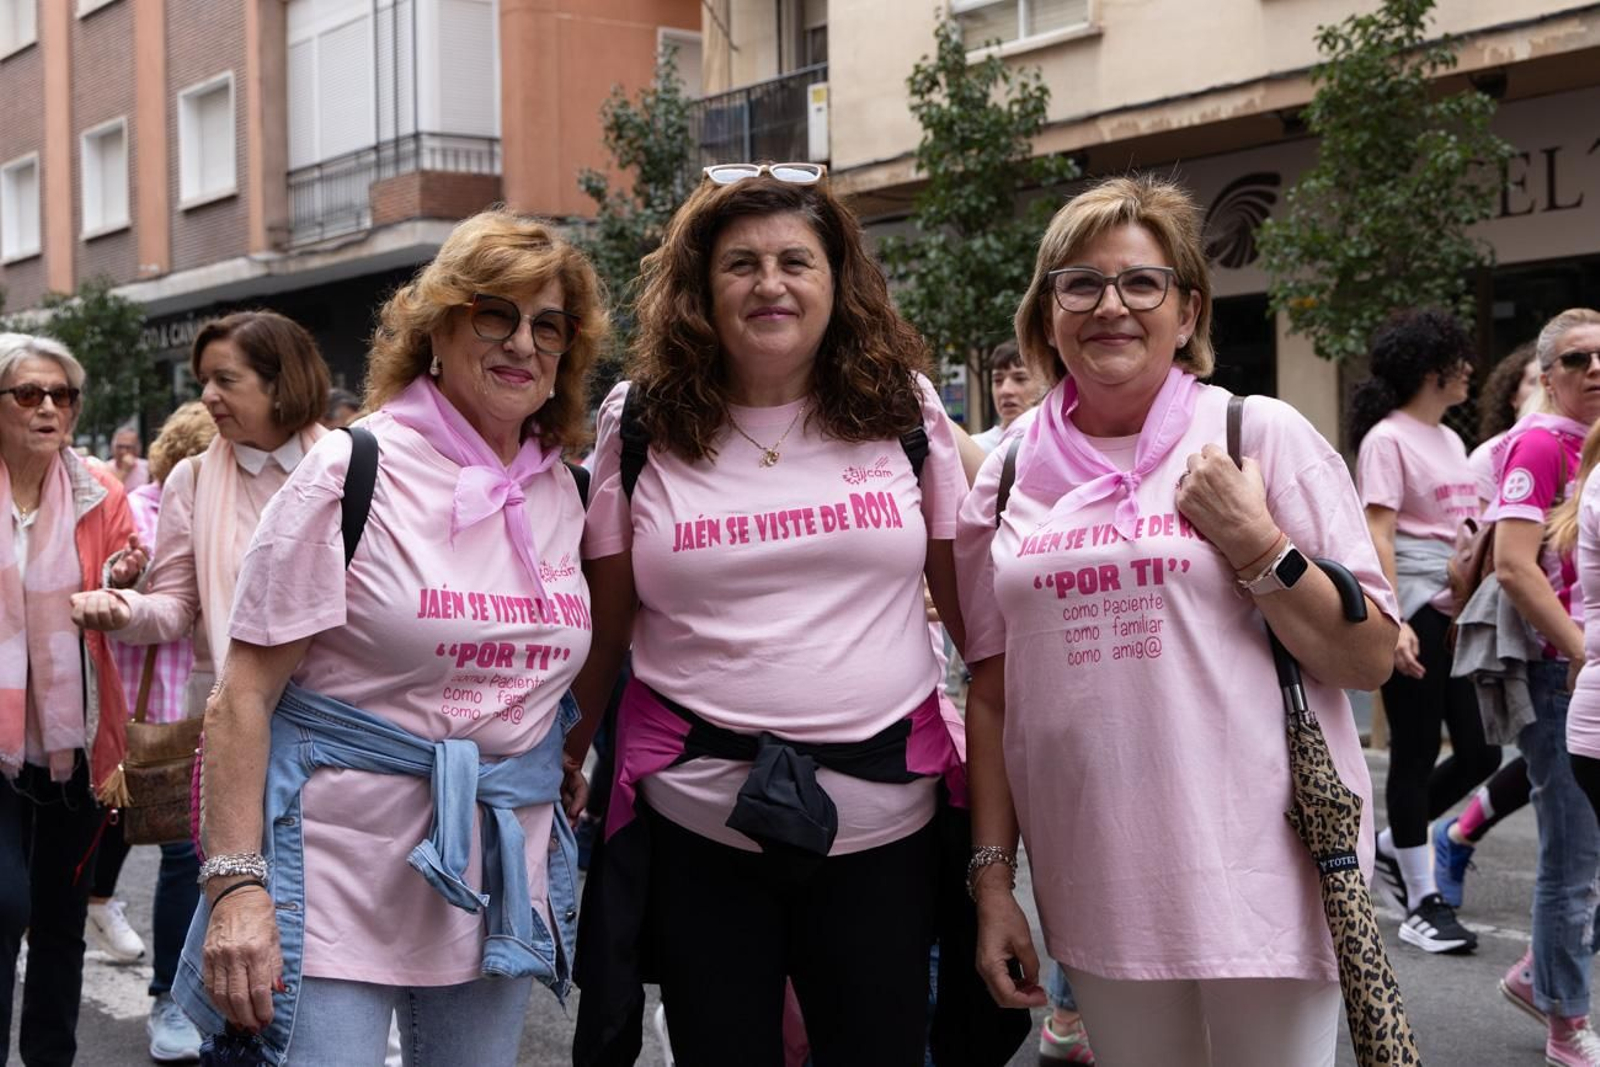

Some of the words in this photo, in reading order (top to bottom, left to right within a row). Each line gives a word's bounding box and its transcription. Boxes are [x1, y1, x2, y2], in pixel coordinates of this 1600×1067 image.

[1464, 146, 1584, 222] EL
[672, 514, 721, 553] JAÉN
[726, 516, 750, 546] SE
[754, 507, 818, 542] VISTE
[819, 502, 850, 534] DE
[849, 491, 904, 530] ROSA
[1016, 528, 1064, 558] JAÉN
[1065, 527, 1088, 551] SE
[1092, 517, 1145, 547] VISE
[1148, 512, 1175, 538] DE
[417, 583, 466, 620] JAÉN
[468, 591, 490, 622] SE
[489, 593, 538, 625] VISTE
[1062, 603, 1099, 621] como
[1103, 592, 1164, 617] paciente
[1065, 625, 1100, 644] como
[1112, 613, 1164, 637] familiar
[1067, 648, 1101, 666] como
[1112, 635, 1163, 660] amig@
[442, 686, 483, 705] como
[441, 704, 481, 721] como
